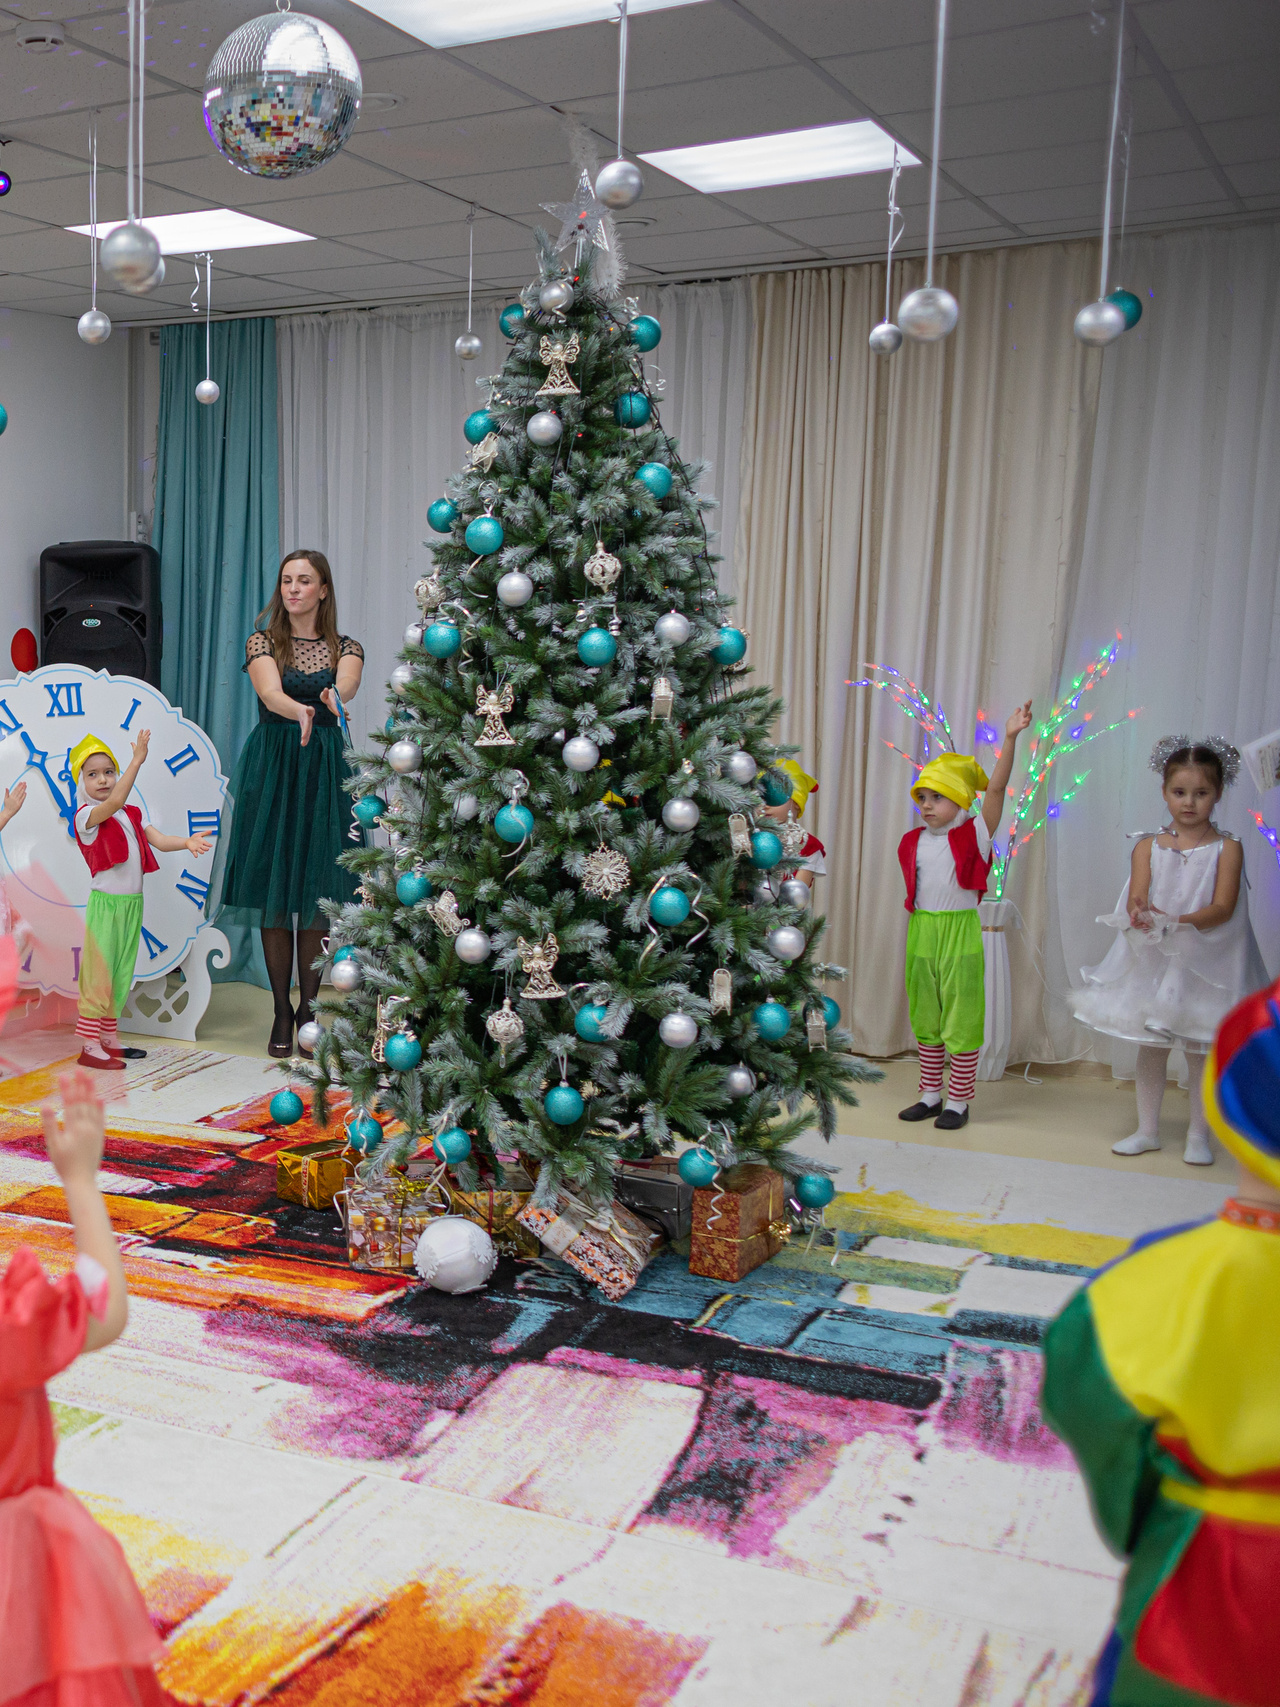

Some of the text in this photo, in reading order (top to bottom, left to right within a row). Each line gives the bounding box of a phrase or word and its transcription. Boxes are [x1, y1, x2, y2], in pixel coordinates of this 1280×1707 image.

[44, 682, 85, 716] XII
[120, 698, 141, 730] I
[164, 745, 200, 776] II
[175, 868, 212, 909] IV
